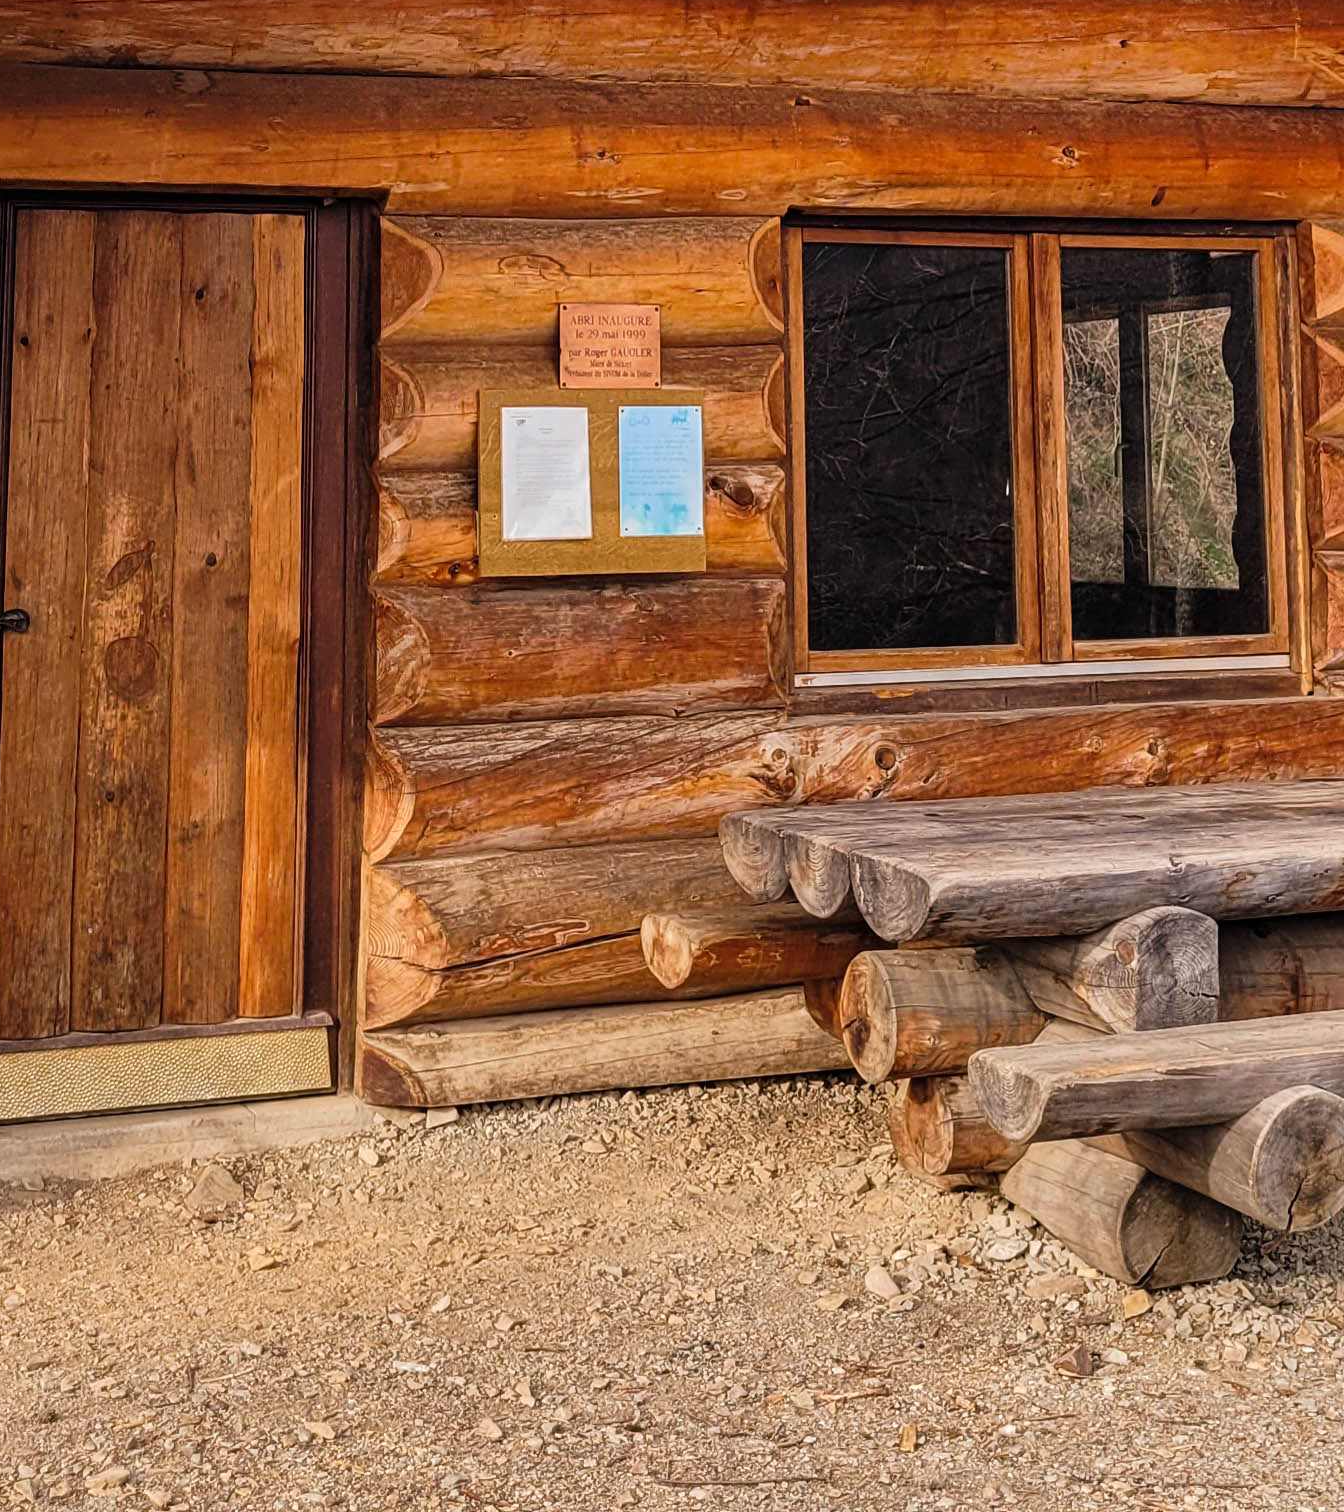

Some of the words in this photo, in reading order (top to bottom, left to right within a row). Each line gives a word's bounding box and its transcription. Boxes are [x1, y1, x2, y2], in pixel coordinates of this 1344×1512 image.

[570, 315, 594, 326] ABRI
[575, 329, 584, 339] le
[586, 329, 599, 339] 29
[602, 329, 618, 339] mai
[622, 329, 646, 339] 1999
[568, 350, 581, 361] par
[584, 347, 608, 358] Roger
[611, 348, 652, 358] GAUGLER
